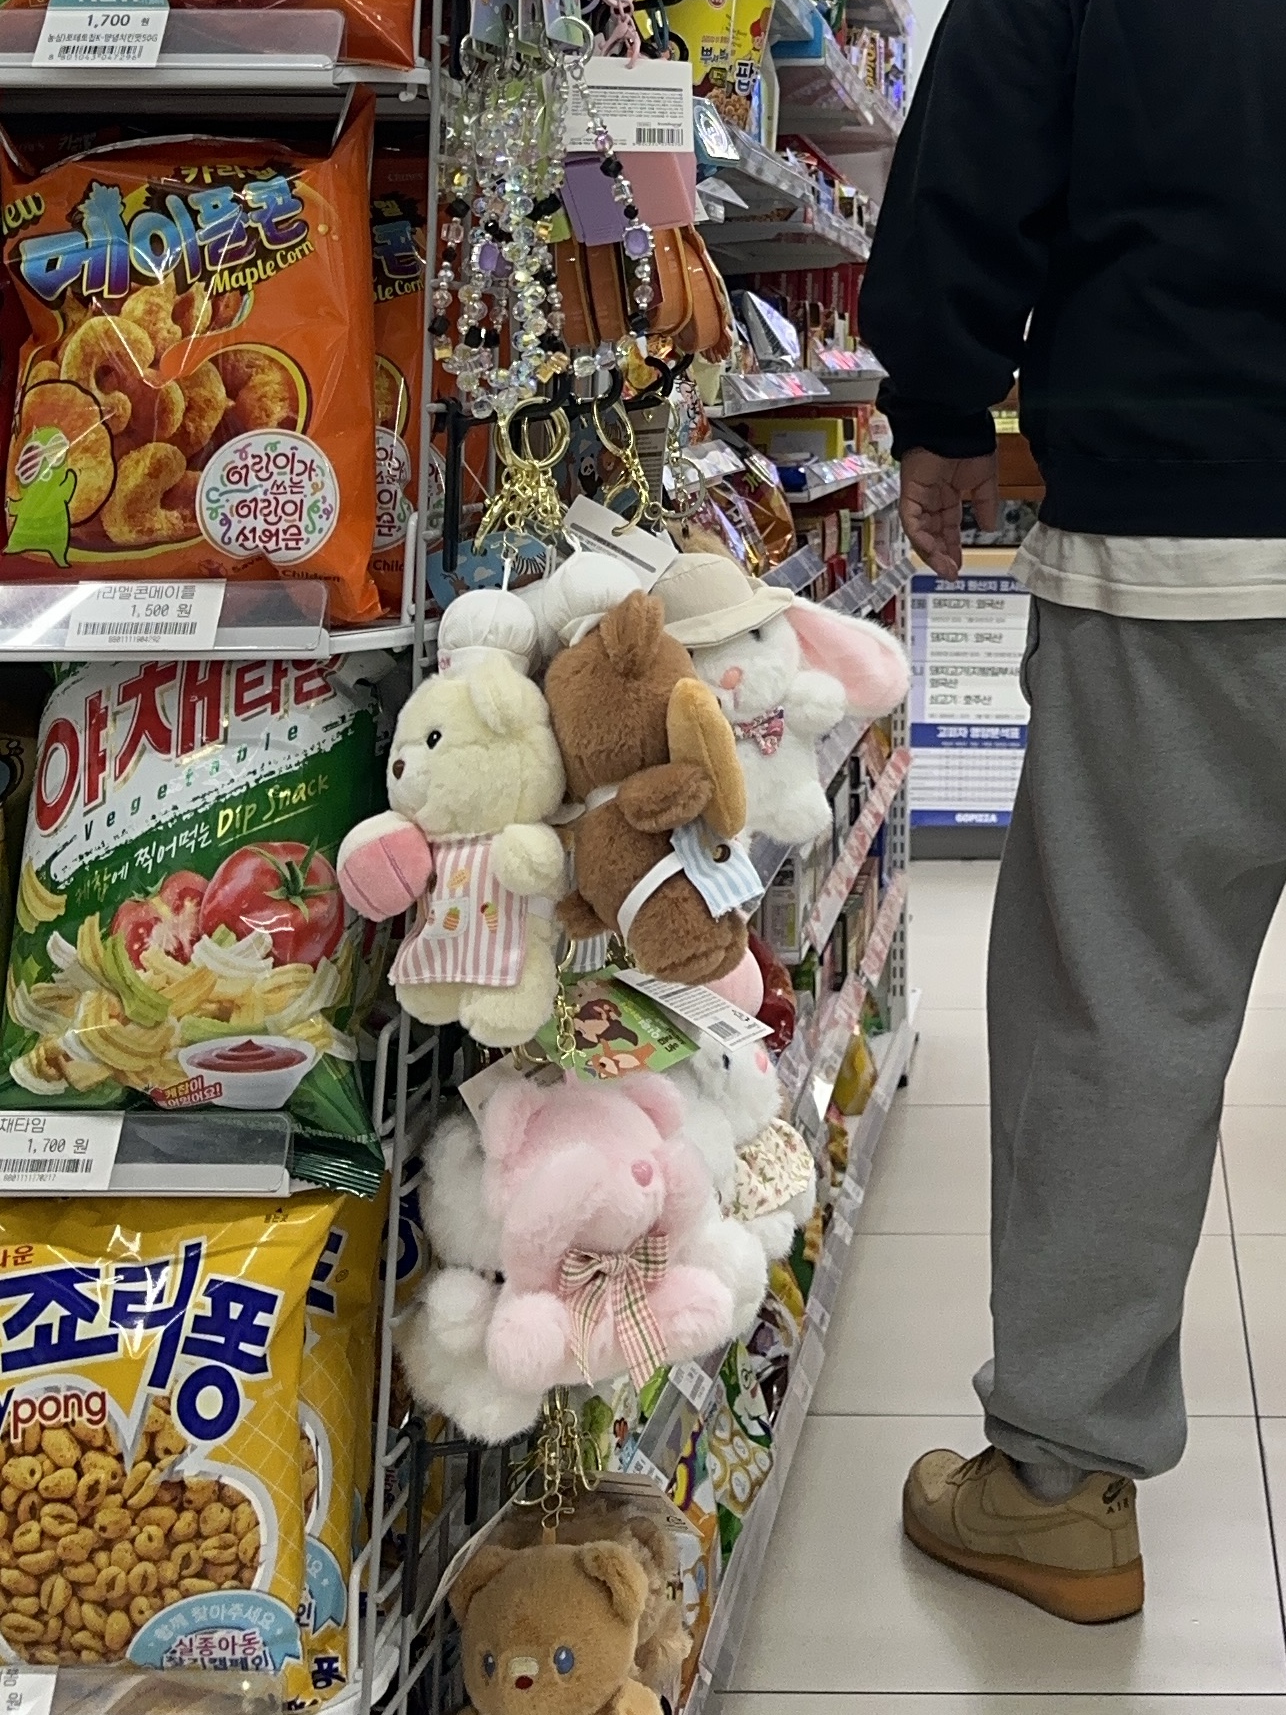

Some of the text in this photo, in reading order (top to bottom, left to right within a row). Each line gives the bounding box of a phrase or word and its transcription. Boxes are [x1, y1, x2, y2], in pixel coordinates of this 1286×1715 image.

[88, 14, 130, 28] 1,700
[0, 193, 46, 233] ew
[19, 177, 308, 301] 메이플콘
[210, 240, 315, 297] Maple Corn
[226, 447, 318, 488] 어린이가
[270, 478, 305, 495] 쓰는
[235, 497, 304, 526] 어린이
[236, 525, 304, 554] 선언문
[281, 569, 342, 583] Children
[96, 585, 196, 600] 라멜콘메이플
[130, 603, 192, 618] 1,500 원
[217, 774, 329, 838] Dip Snack
[134, 822, 212, 873] 찍어먹는
[27, 1138, 89, 1154] 1,700 원
[0, 1242, 281, 1441] 죠리퐁
[13, 1391, 107, 1442] pong
[1106, 1498, 1129, 1514] AIR
[175, 1630, 260, 1657] 실종아동
